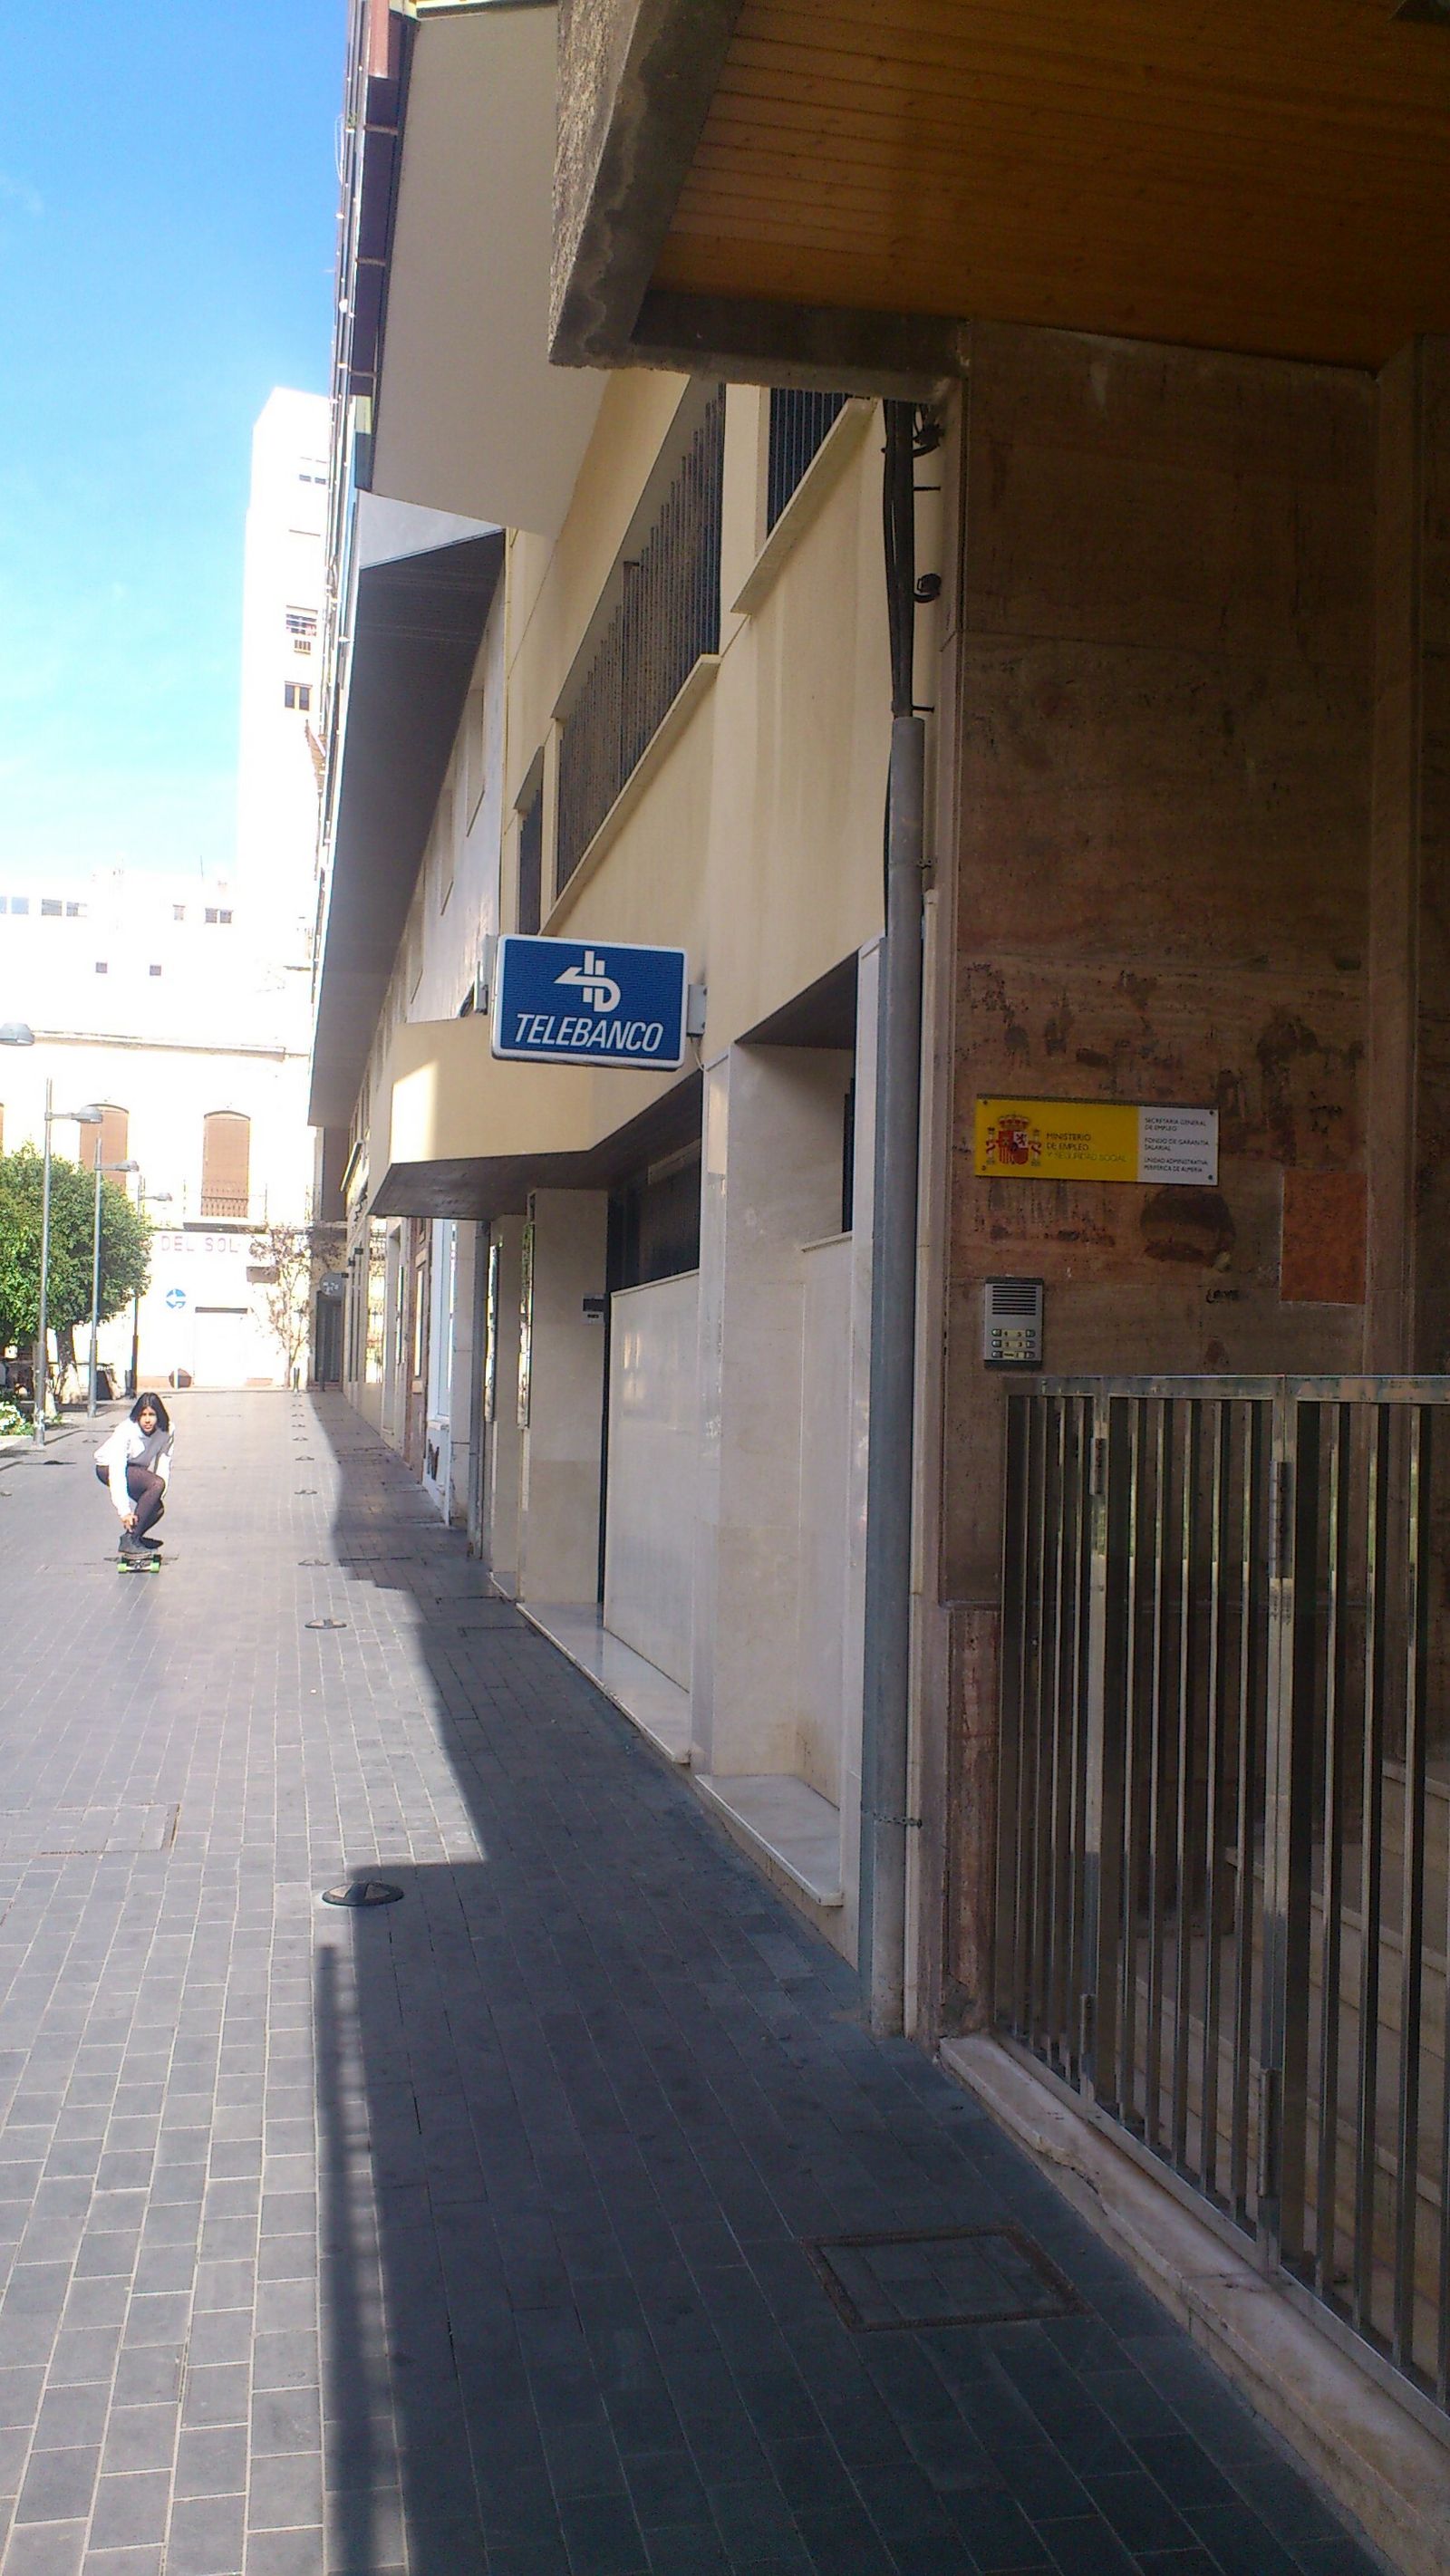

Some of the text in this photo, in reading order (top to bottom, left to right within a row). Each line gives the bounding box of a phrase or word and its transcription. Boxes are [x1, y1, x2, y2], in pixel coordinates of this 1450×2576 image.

[515, 1013, 663, 1052] TELEBANCO
[1046, 1133, 1091, 1142] MINISTERIO
[1046, 1142, 1089, 1152] DE EMPLEO
[160, 1235, 238, 1253] DEL SOL
